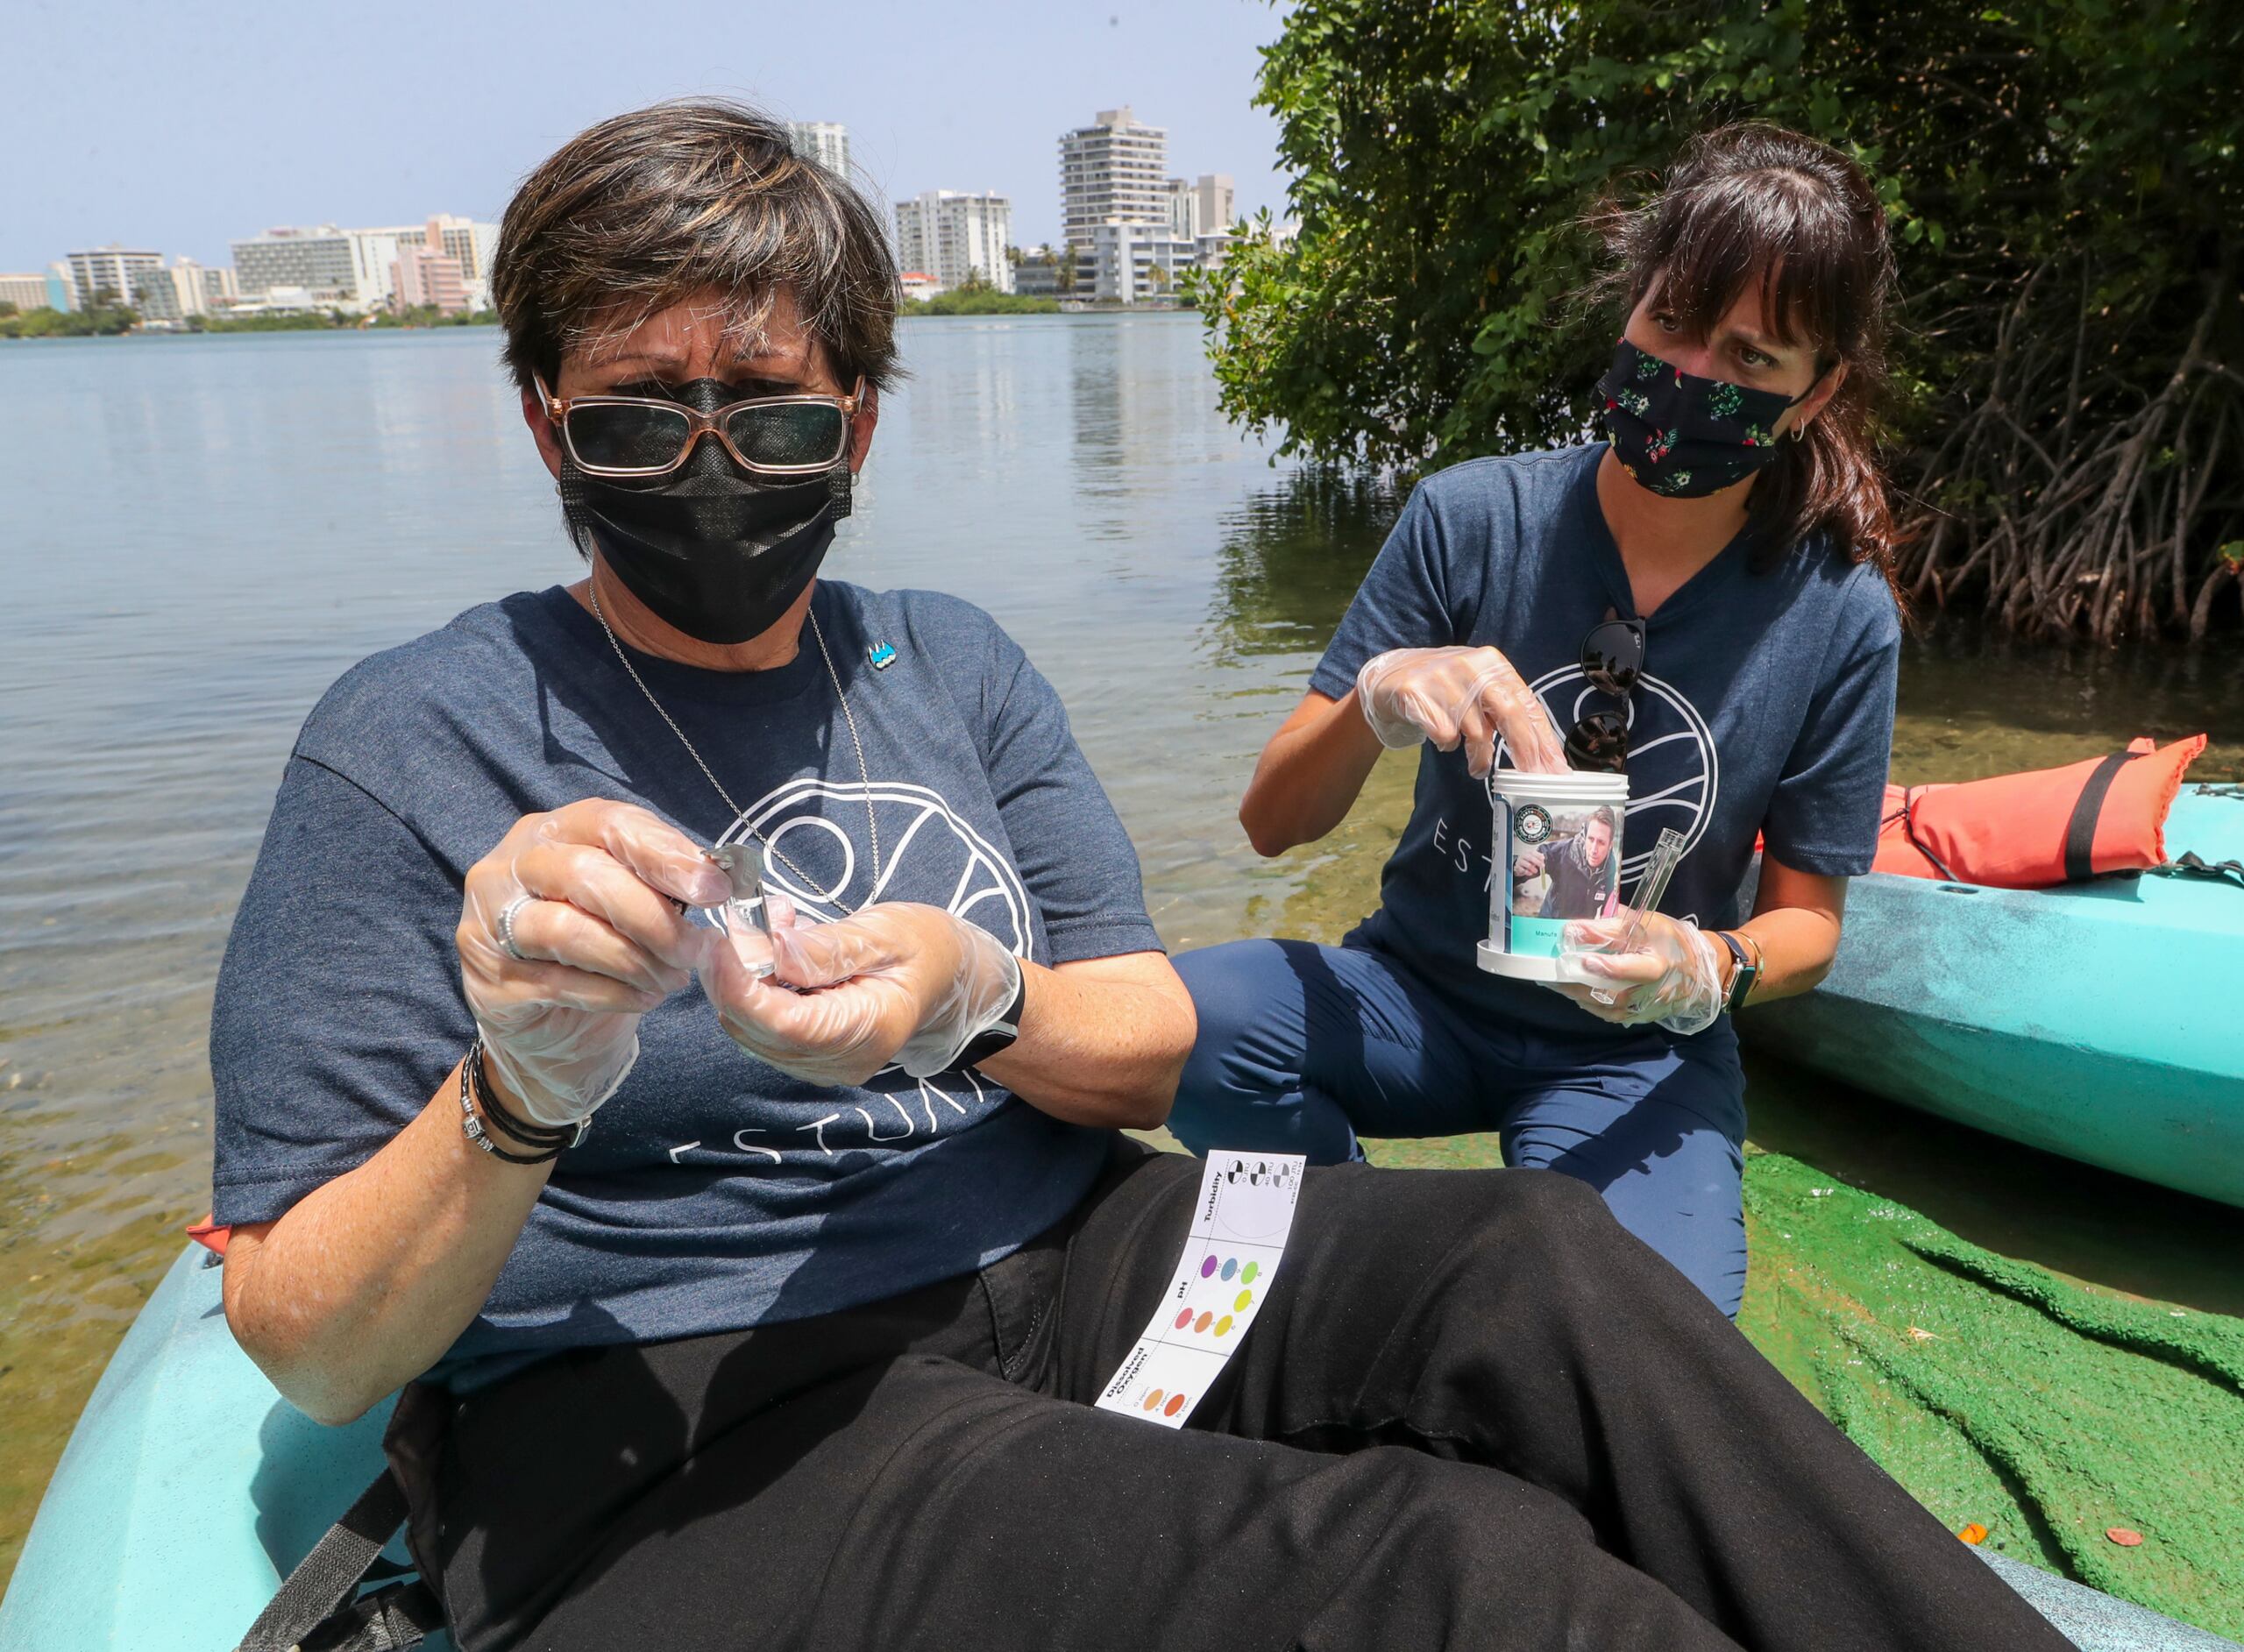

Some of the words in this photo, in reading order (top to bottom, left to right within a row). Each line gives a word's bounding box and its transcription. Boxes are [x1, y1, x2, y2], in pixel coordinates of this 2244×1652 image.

[1264, 1176, 1271, 1187] 40
[1290, 1160, 1299, 1174] JTU
[1204, 1171, 1223, 1223] Turbidity
[1177, 1281, 1188, 1299] pH
[1106, 1347, 1145, 1399] Dissolved
[1117, 1353, 1148, 1395] Oxygen
